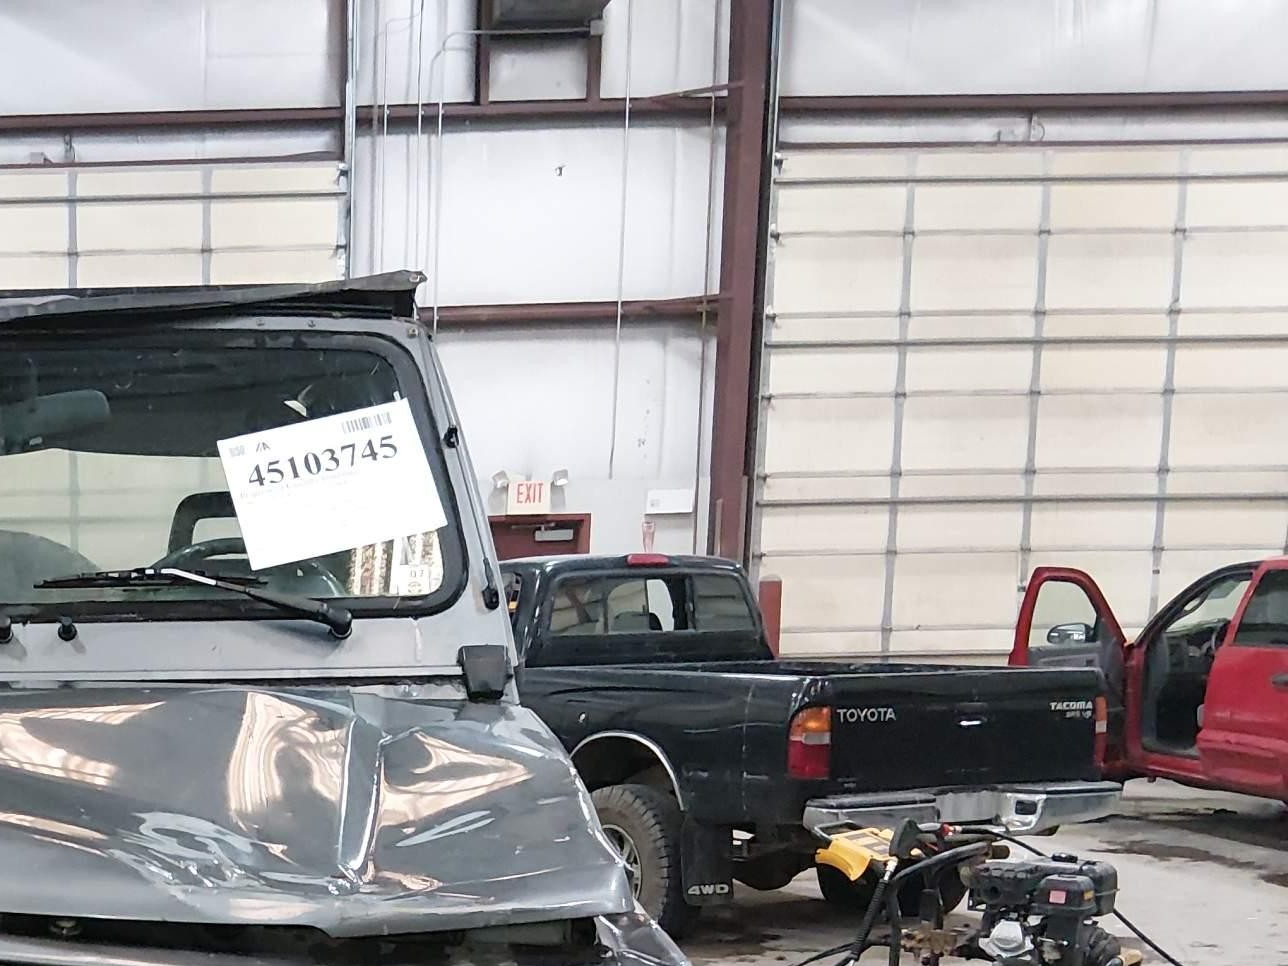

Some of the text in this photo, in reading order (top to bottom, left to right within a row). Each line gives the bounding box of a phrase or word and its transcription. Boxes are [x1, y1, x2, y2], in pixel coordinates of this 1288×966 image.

[248, 434, 398, 487] 45103745
[516, 482, 544, 504] EXIT
[1049, 700, 1093, 711] TACOMA
[836, 707, 897, 724] TOYOTA
[687, 883, 730, 896] 4WD
